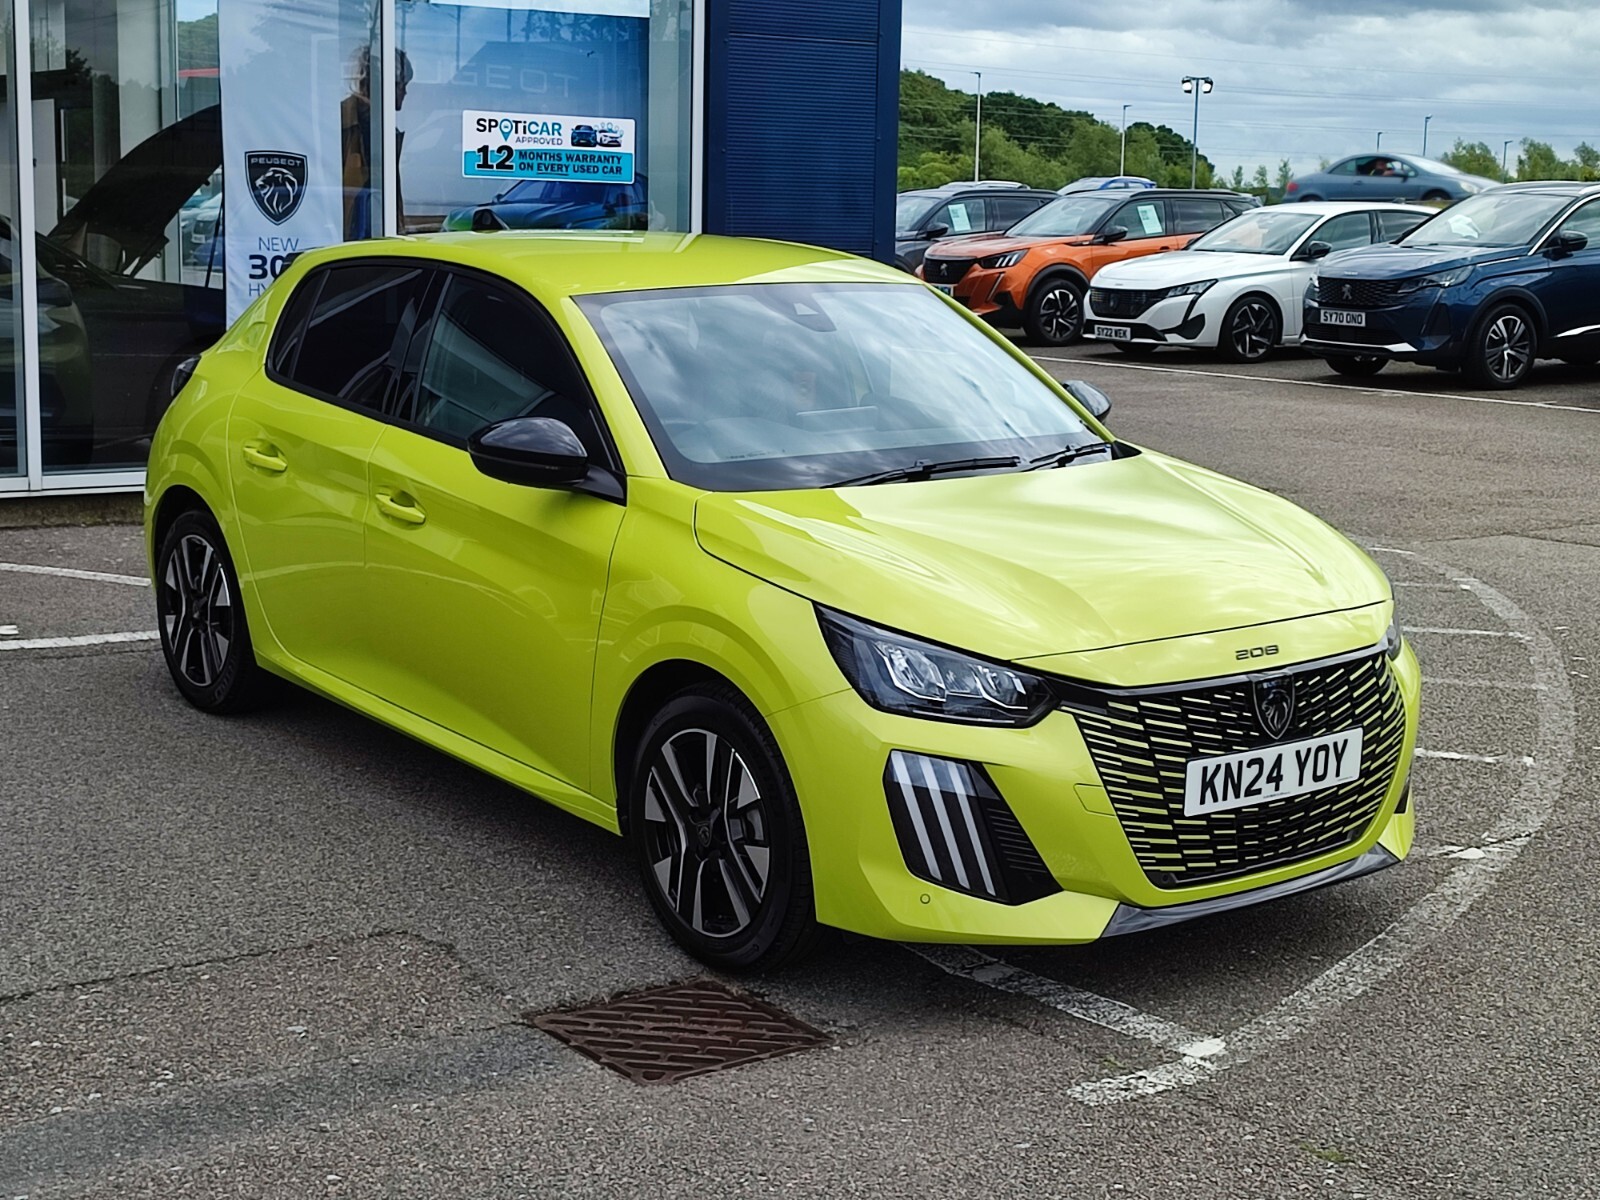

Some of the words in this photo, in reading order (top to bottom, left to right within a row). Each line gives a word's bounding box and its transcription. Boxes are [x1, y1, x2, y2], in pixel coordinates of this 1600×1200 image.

[515, 136, 563, 146] APPROVED
[250, 157, 302, 166] PEUGEOT
[475, 145, 515, 171] 12
[518, 151, 562, 162] MONTHS
[565, 152, 622, 164] WARRANTY
[519, 161, 534, 171] ON
[537, 163, 569, 174] EVERY
[573, 164, 599, 174] USED
[602, 165, 622, 175] CAR
[258, 236, 299, 251] NEW
[248, 254, 285, 280] 30
[1323, 310, 1344, 323] SY70
[1096, 326, 1113, 338] SY22
[1235, 644, 1279, 661] 208
[1199, 753, 1284, 806] KN24
[1295, 738, 1349, 787] YOY
